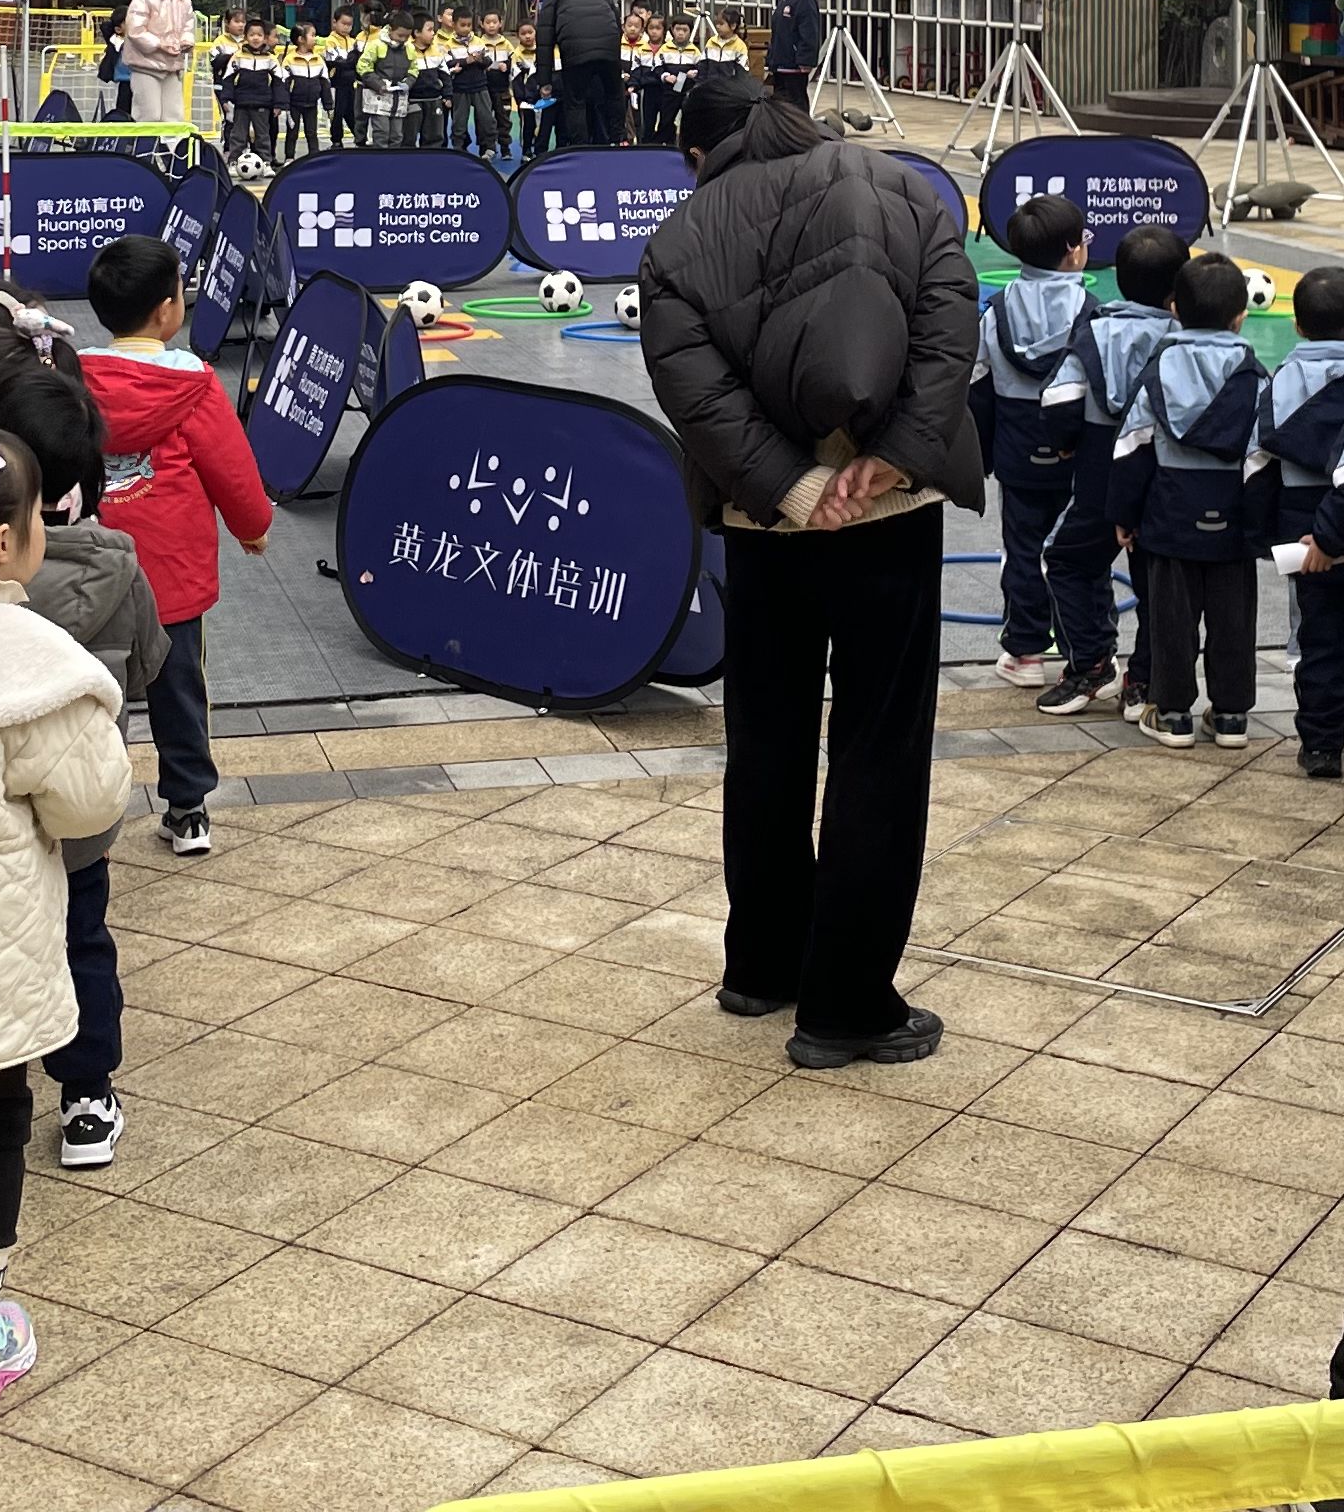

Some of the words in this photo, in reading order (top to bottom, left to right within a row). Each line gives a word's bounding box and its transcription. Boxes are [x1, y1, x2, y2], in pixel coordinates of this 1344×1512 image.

[1086, 176, 1178, 192] 黄龙体育中心
[378, 193, 481, 210] 黄龙体育中心
[616, 188, 693, 205] 黄龙体育中
[1087, 195, 1162, 210] Huanglong
[36, 195, 144, 215] 黄龙体育中心
[379, 212, 462, 228] Huanglong
[619, 206, 675, 221] Huangl
[1087, 211, 1129, 225] Sports
[1133, 211, 1178, 224] Centre
[38, 217, 126, 234] Huanglong
[621, 223, 660, 239] Sport
[37, 237, 87, 252] Sports
[379, 230, 425, 246] Sports
[430, 230, 480, 243] Centre
[388, 521, 627, 621] 黄龙文体培训
